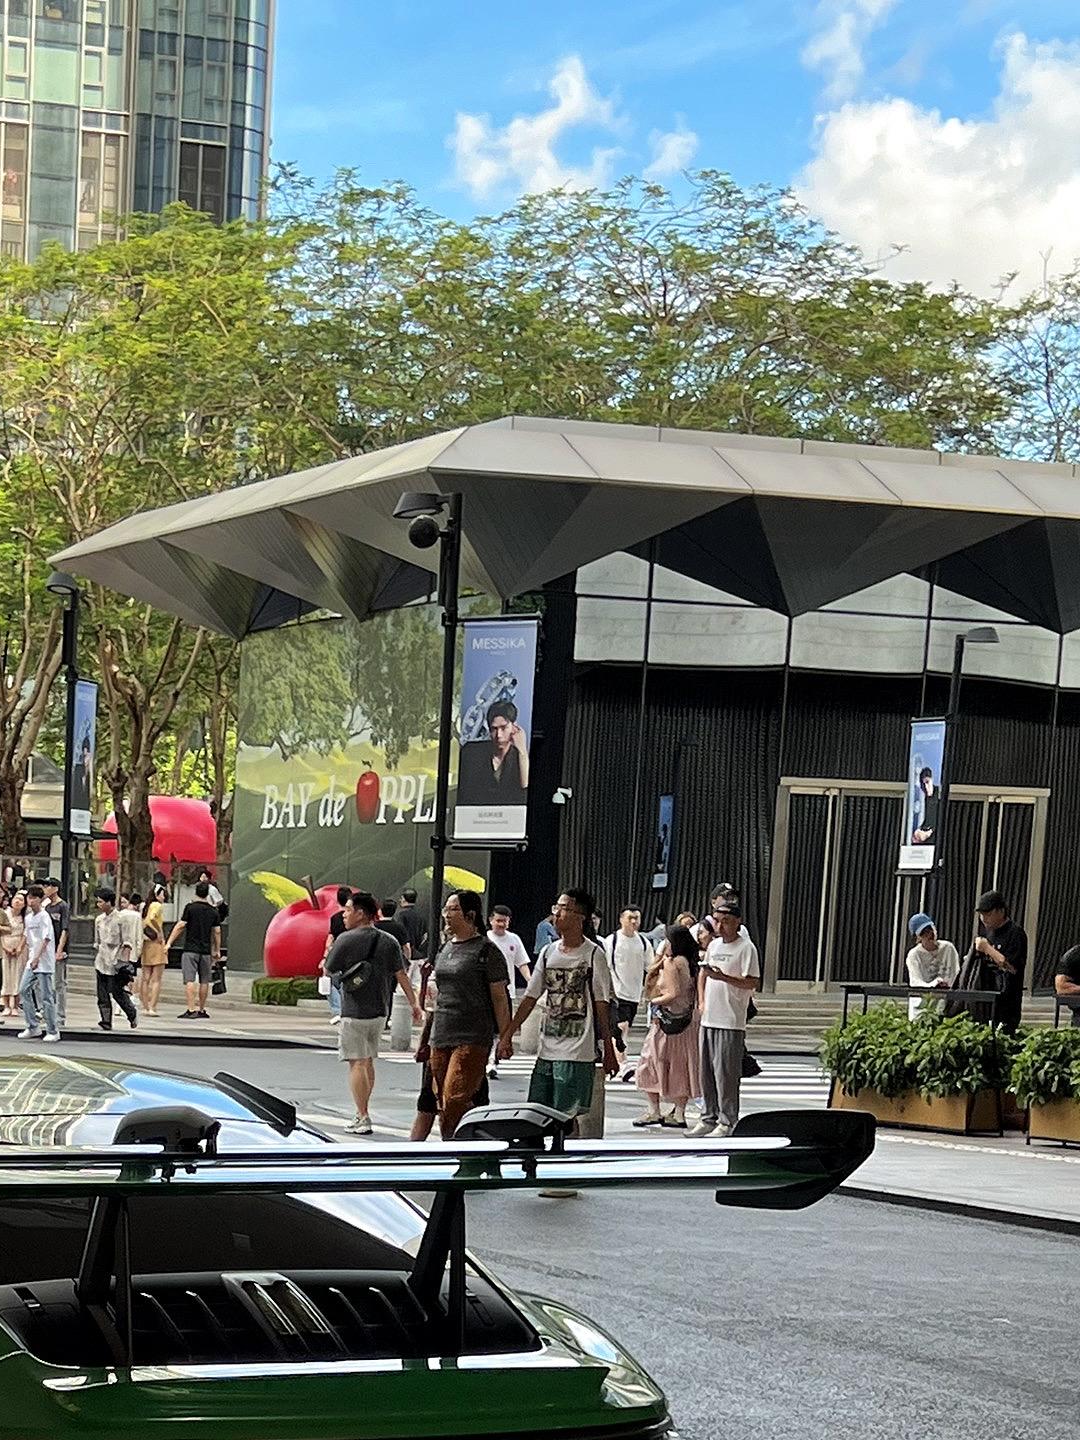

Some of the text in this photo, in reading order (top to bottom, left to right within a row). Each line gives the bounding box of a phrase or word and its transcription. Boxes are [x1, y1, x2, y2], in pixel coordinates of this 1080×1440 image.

[472, 637, 527, 650] MESSIKA
[260, 782, 315, 830] BAY
[319, 775, 346, 827] de
